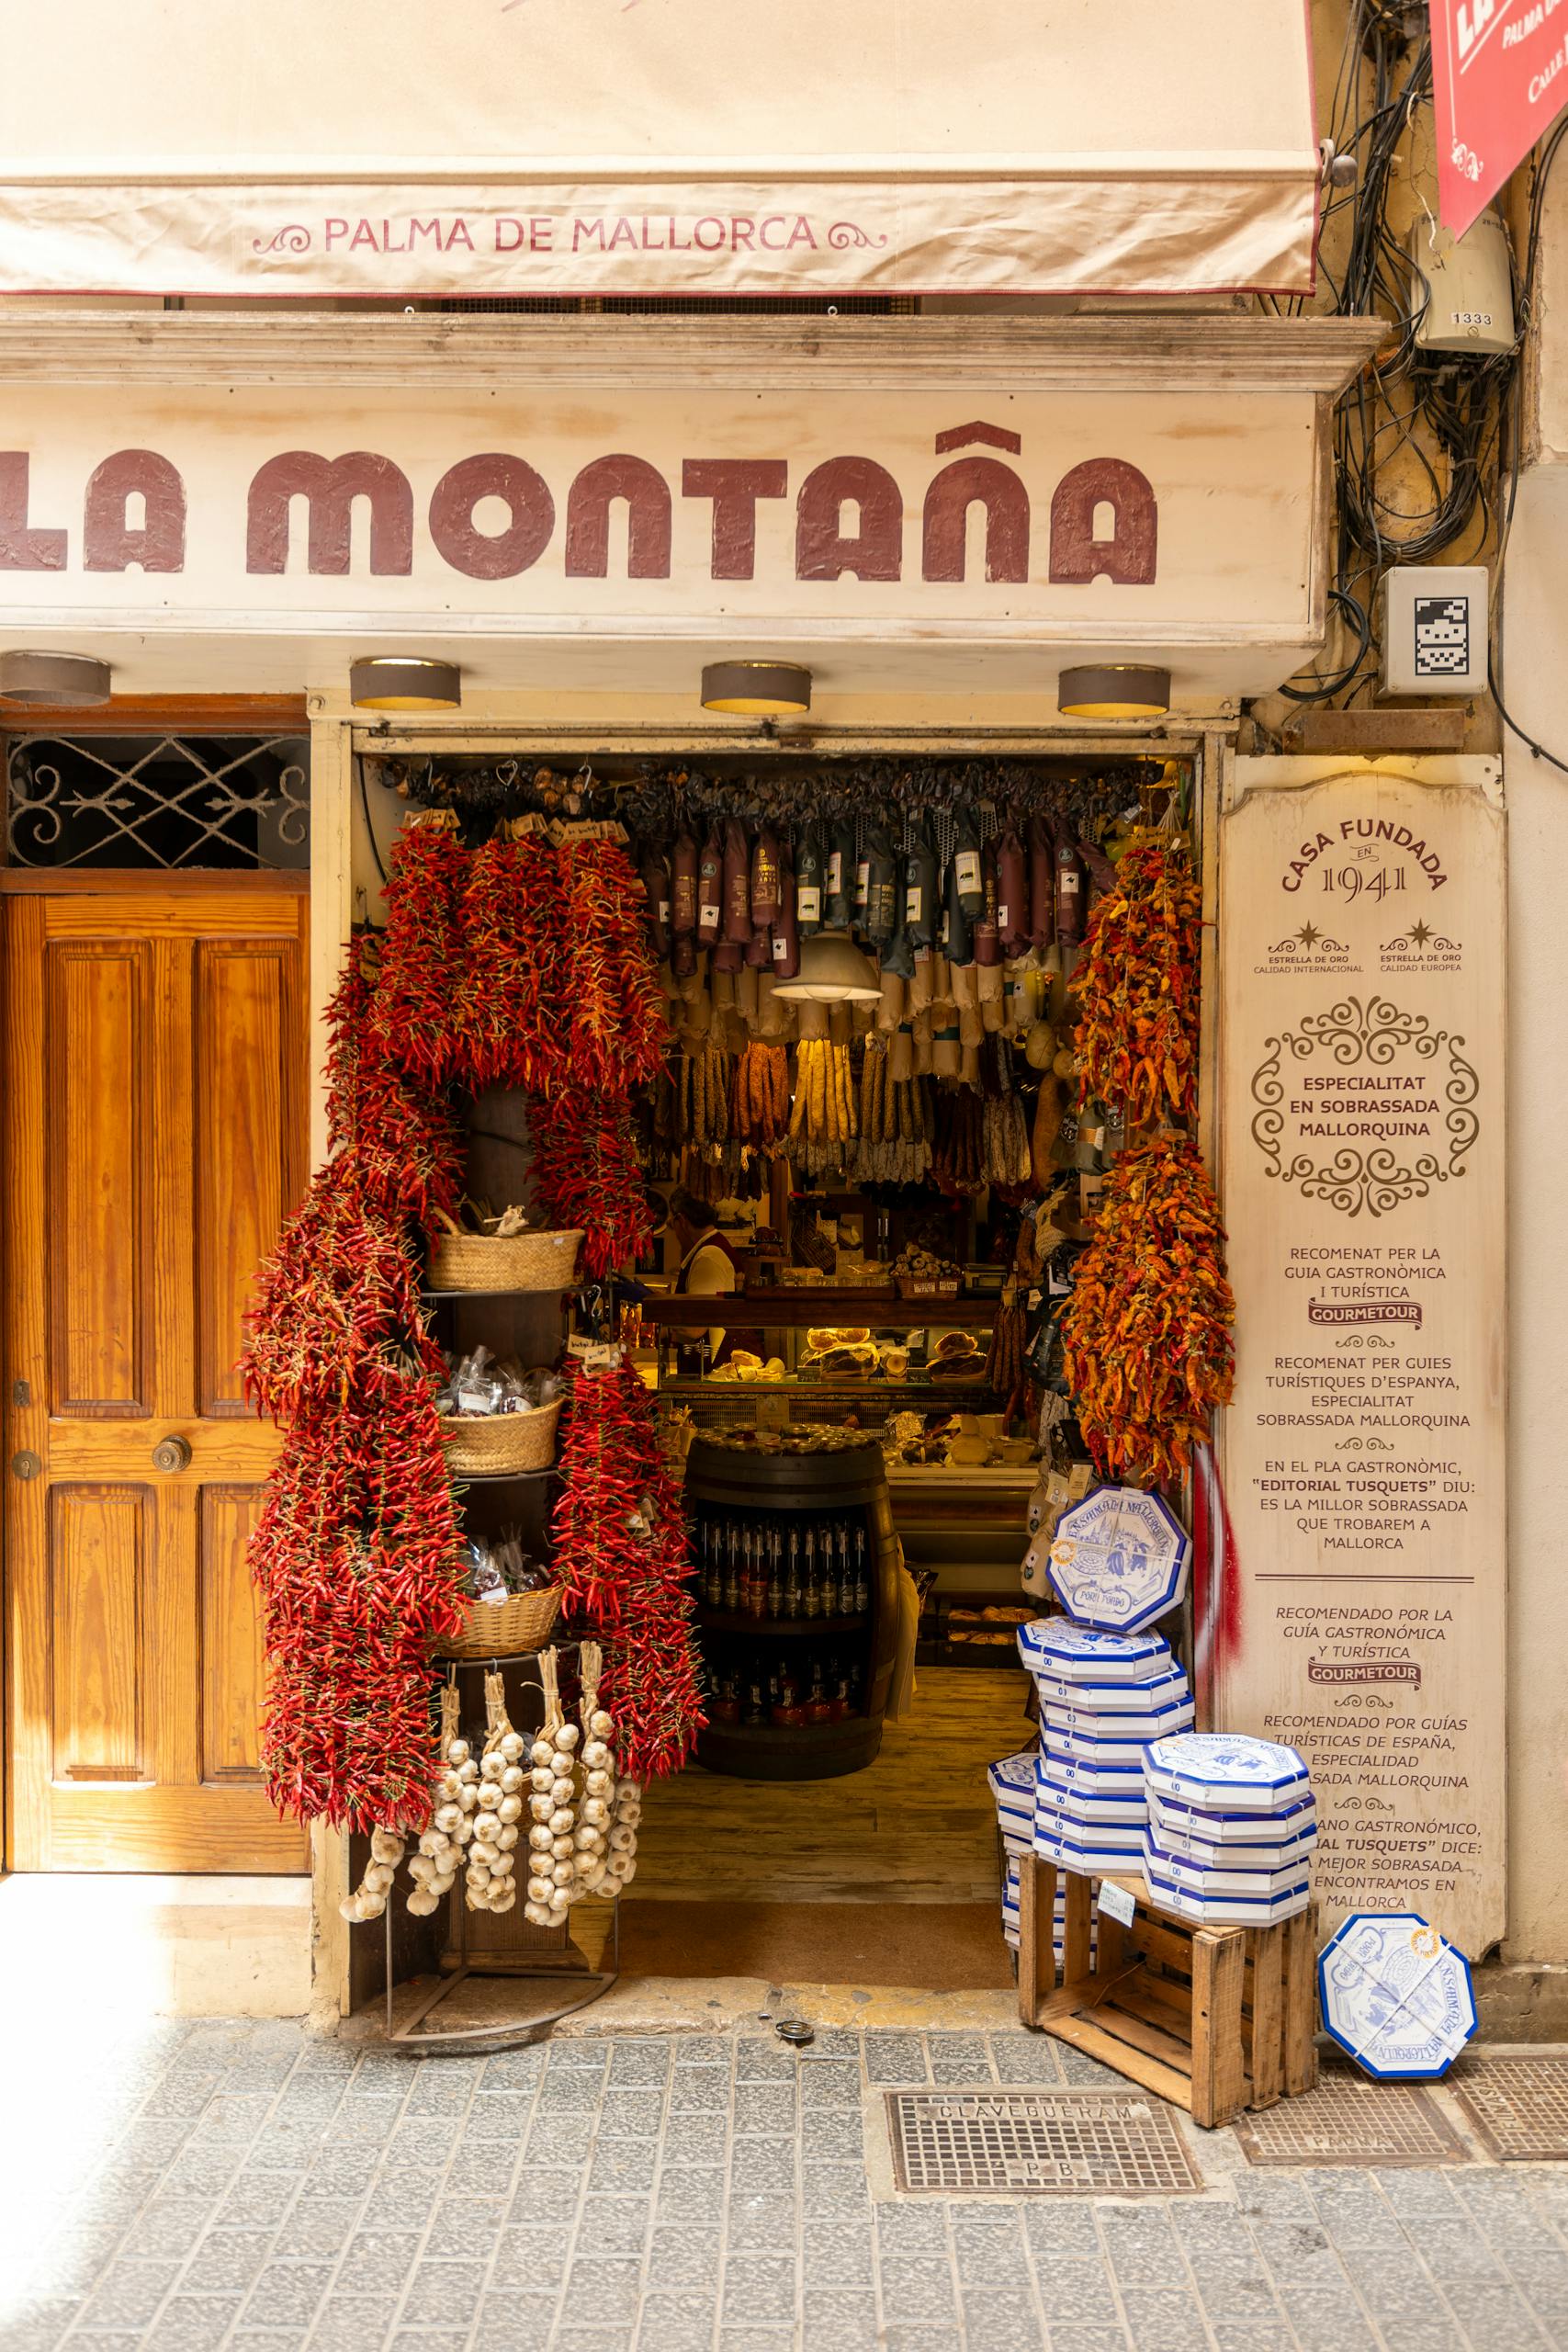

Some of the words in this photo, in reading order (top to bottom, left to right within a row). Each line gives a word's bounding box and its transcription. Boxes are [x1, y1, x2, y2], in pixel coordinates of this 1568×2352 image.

[1457, 0, 1495, 60] LA
[1503, 4, 1544, 49] PALMA
[325, 217, 476, 253] PALMA
[495, 217, 554, 252] DE
[572, 215, 819, 252] MALLORCA
[1453, 313, 1492, 324] 1333
[0, 448, 187, 572] LA
[1281, 831, 1336, 893] CASA
[1339, 819, 1449, 891] FUNDADA
[1357, 847, 1372, 857] EN
[1321, 865, 1406, 904] 1941
[1269, 956, 1313, 964] ESTRELLA
[1314, 956, 1327, 964] DE
[1329, 956, 1349, 964] ORO
[1380, 955, 1425, 963] ESTRELLA
[1427, 954, 1439, 962] DE
[1441, 954, 1462, 962] ORO
[1253, 966, 1292, 975] CALIDAD
[1293, 965, 1364, 974] INTERNACIONAL
[1380, 964, 1419, 972] CALIDAD
[1420, 964, 1462, 972] EUROPEA
[1303, 1077, 1427, 1091] ESPECIALITAT
[1290, 1100, 1314, 1114] EN
[1320, 1099, 1440, 1114] SOBRASSADA
[1299, 1123, 1431, 1142] MALLORQUINA
[1291, 1248, 1382, 1261] RECOMENAT
[1388, 1248, 1416, 1260] PER
[1422, 1248, 1441, 1261] LA
[1284, 1266, 1321, 1279] GUIA
[1325, 1262, 1447, 1279] GASTRONÒMICA
[1321, 1285, 1325, 1298] I
[1330, 1282, 1410, 1298] TURÍSTICA
[1312, 1306, 1418, 1320] GOURMETOUR
[1274, 1357, 1367, 1369] RECOMENAT
[1372, 1357, 1401, 1369] PER
[1405, 1357, 1451, 1370] GUIES
[1265, 1372, 1366, 1393] TURÍSTIQUES
[1312, 1395, 1415, 1408] ESPECIALITAT
[1257, 1414, 1355, 1427] SOBRASSADA
[1359, 1414, 1471, 1431] MALLORQUINA
[1265, 1461, 1285, 1473] EN
[1291, 1461, 1309, 1473] EL
[1314, 1461, 1342, 1473] PLA
[1346, 1457, 1461, 1476] GASTRONÒMIC,
[1443, 1481, 1475, 1493] DIU:
[1260, 1498, 1279, 1510] ES
[1284, 1498, 1303, 1510] LA
[1307, 1498, 1363, 1511] MILLOR
[1368, 1499, 1469, 1512] SOBRASSADA
[1296, 1518, 1328, 1534] QUE
[1333, 1518, 1416, 1531] TROBAREM
[1419, 1519, 1431, 1531] A
[1324, 1537, 1404, 1550] MALLORCA
[1276, 1607, 1393, 1621] RECOMENDADO
[1398, 1609, 1429, 1622] POR
[1434, 1609, 1453, 1622] LA
[1282, 1622, 1321, 1638] GUÍA
[1325, 1623, 1447, 1641] GASTRONÓMICA
[1318, 1645, 1328, 1657] Y
[1332, 1641, 1411, 1659] TURÍSTICA
[1312, 1667, 1417, 1680] GOURMETOUR
[1263, 1714, 1380, 1729] RECOMENDADO
[1385, 1717, 1416, 1730] POR
[1421, 1714, 1468, 1731] GUÍAS
[1274, 1729, 1360, 1747] TURÍSTICAS
[1366, 1736, 1387, 1748] DE
[1392, 1734, 1456, 1752] ESPAÑA,
[1311, 1753, 1419, 1768] ESPECIALIDAD
[1357, 1773, 1470, 1792] MALLORQUINA
[1354, 1817, 1481, 1838] GASTRONÓMICO,
[1441, 1841, 1483, 1854] DICE:
[1317, 1857, 1366, 1874] MEJOR
[1371, 1859, 1461, 1872] SOBRASADA
[1314, 1875, 1430, 1891] ENCONTRAMOS
[1435, 1879, 1456, 1892] EN
[1325, 1894, 1406, 1909] MALLORCA
[939, 2104, 1133, 2120] CLAVEGUERAM
[1313, 2135, 1391, 2148] PALMA
